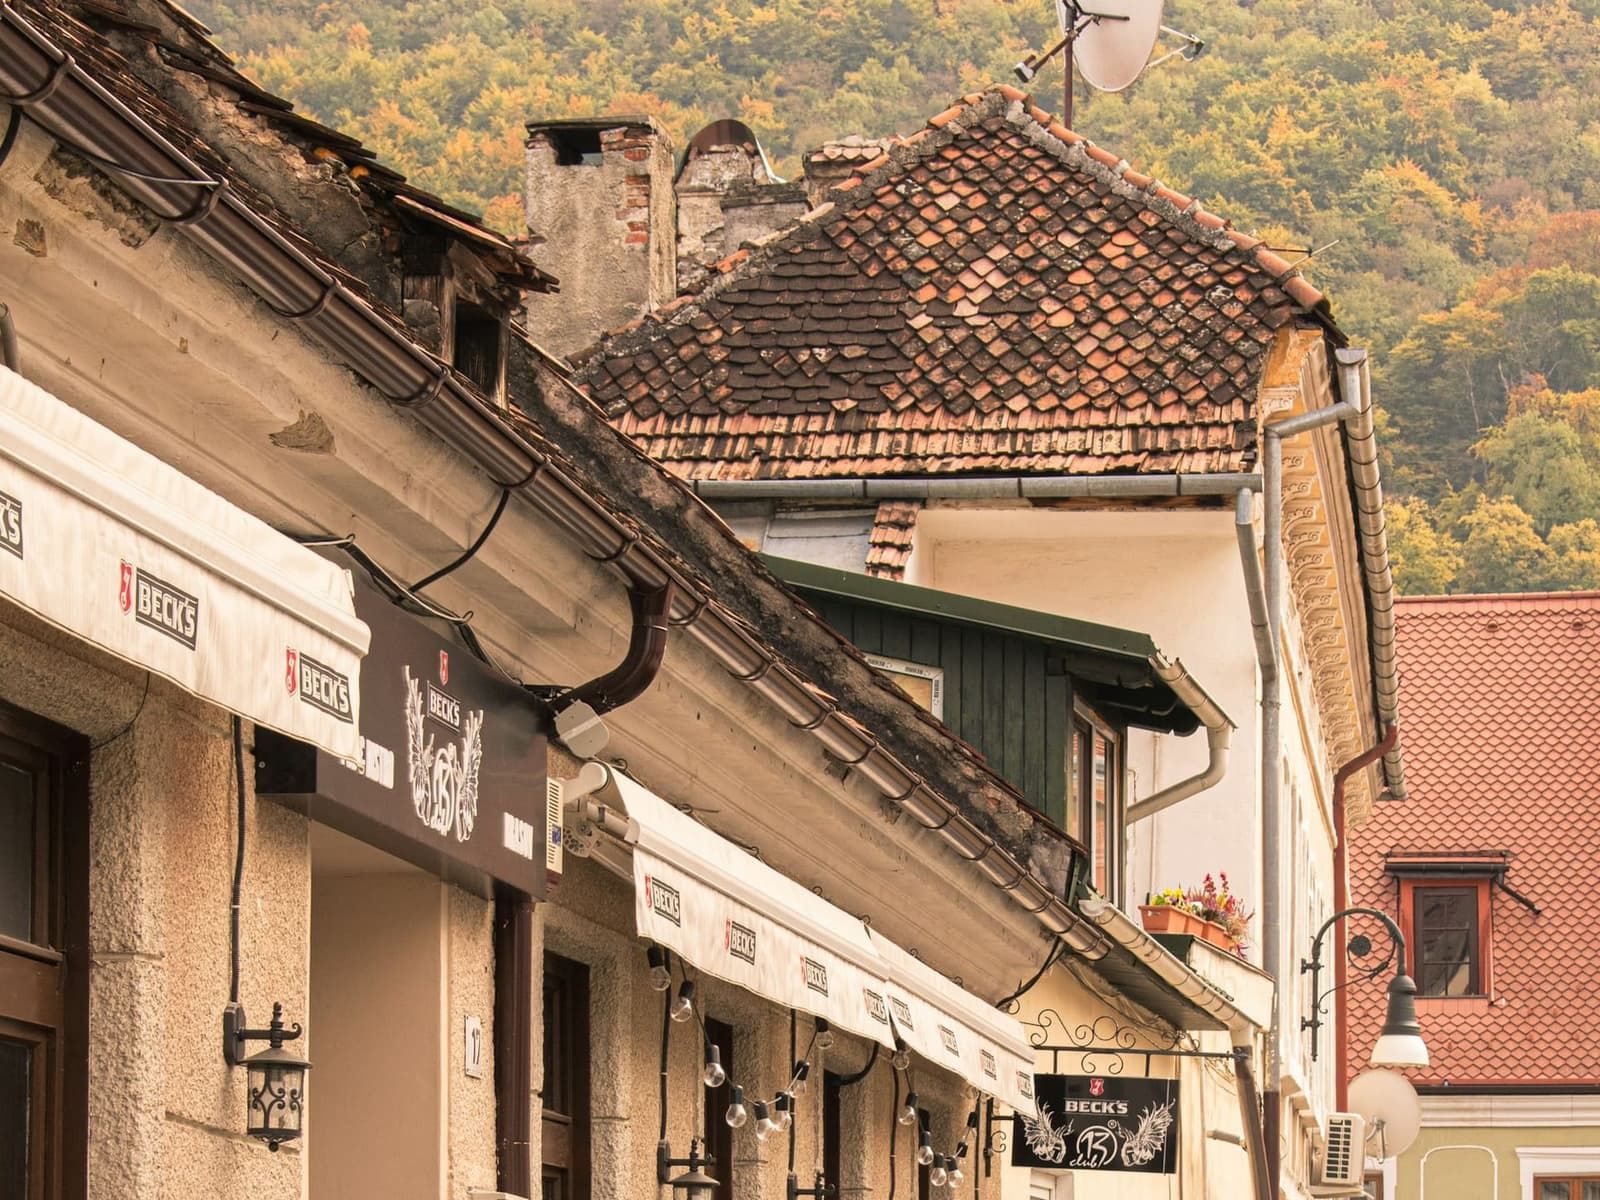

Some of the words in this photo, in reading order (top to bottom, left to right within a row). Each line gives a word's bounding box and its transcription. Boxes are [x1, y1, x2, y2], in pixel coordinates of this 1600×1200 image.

[138, 579, 195, 638] BECK'S
[301, 663, 350, 713] BECK'S
[430, 690, 460, 727] BECK'S
[654, 884, 680, 920] BECK'S
[731, 927, 756, 961] BECK'S
[471, 1027, 481, 1065] 17
[1065, 1100, 1128, 1115] BECK'S
[1069, 1153, 1099, 1168] club
